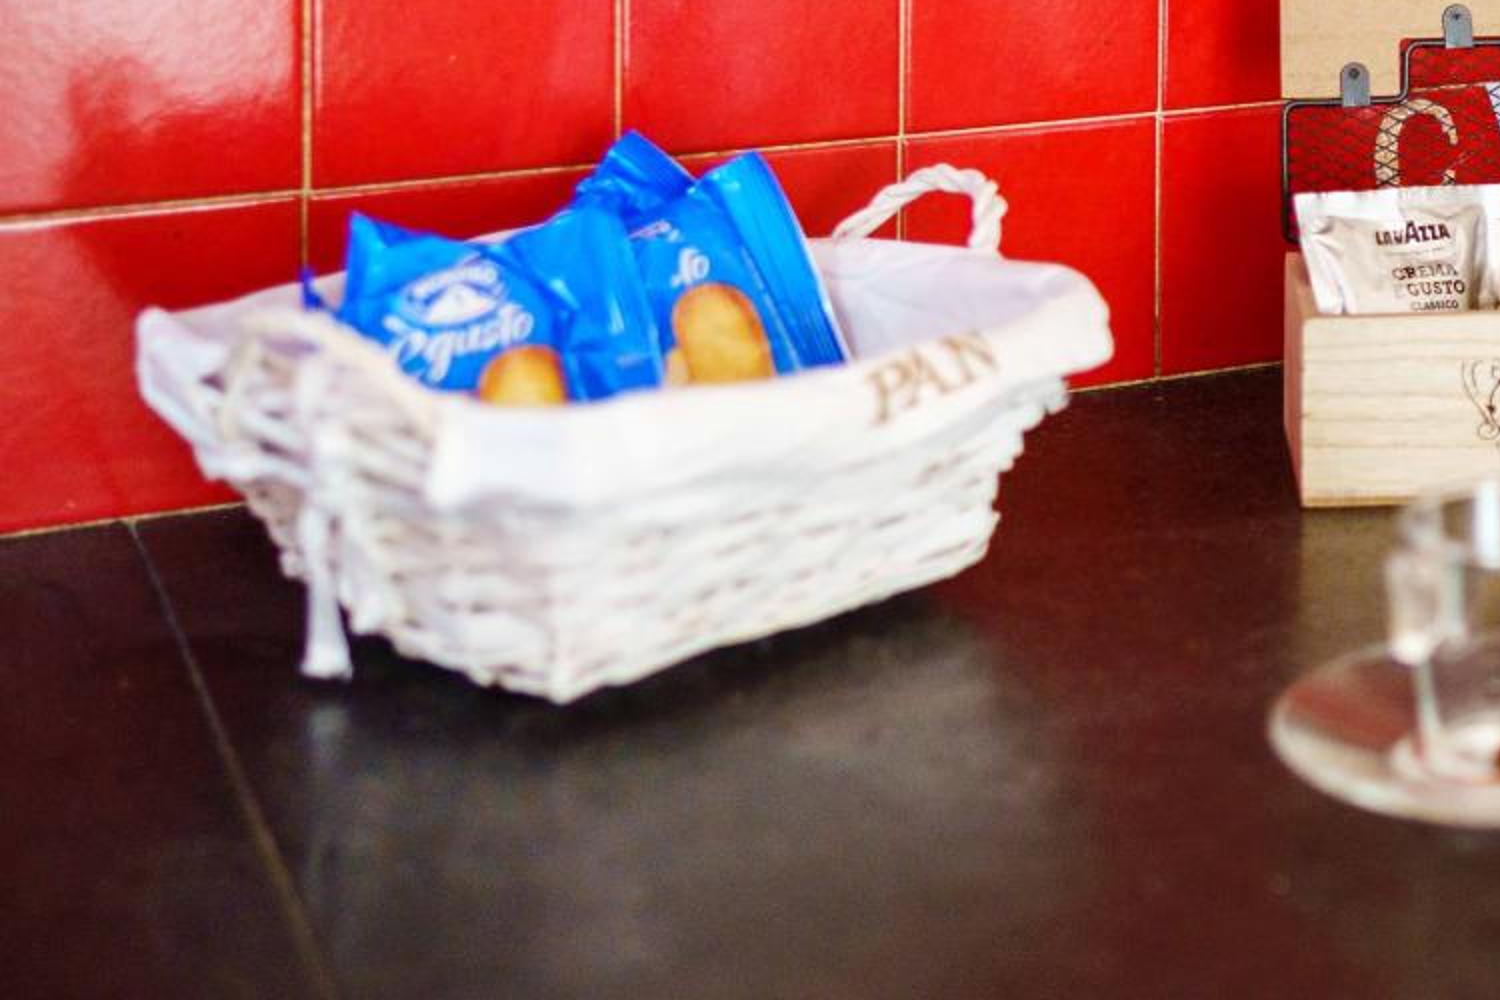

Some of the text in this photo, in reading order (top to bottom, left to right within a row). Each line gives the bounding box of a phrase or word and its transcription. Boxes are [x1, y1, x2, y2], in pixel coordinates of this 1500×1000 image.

[1374, 220, 1450, 246] LAVAZZA
[1391, 263, 1459, 281] CREMA
[1407, 279, 1466, 297] GUSTO
[866, 328, 1001, 428] PAN
